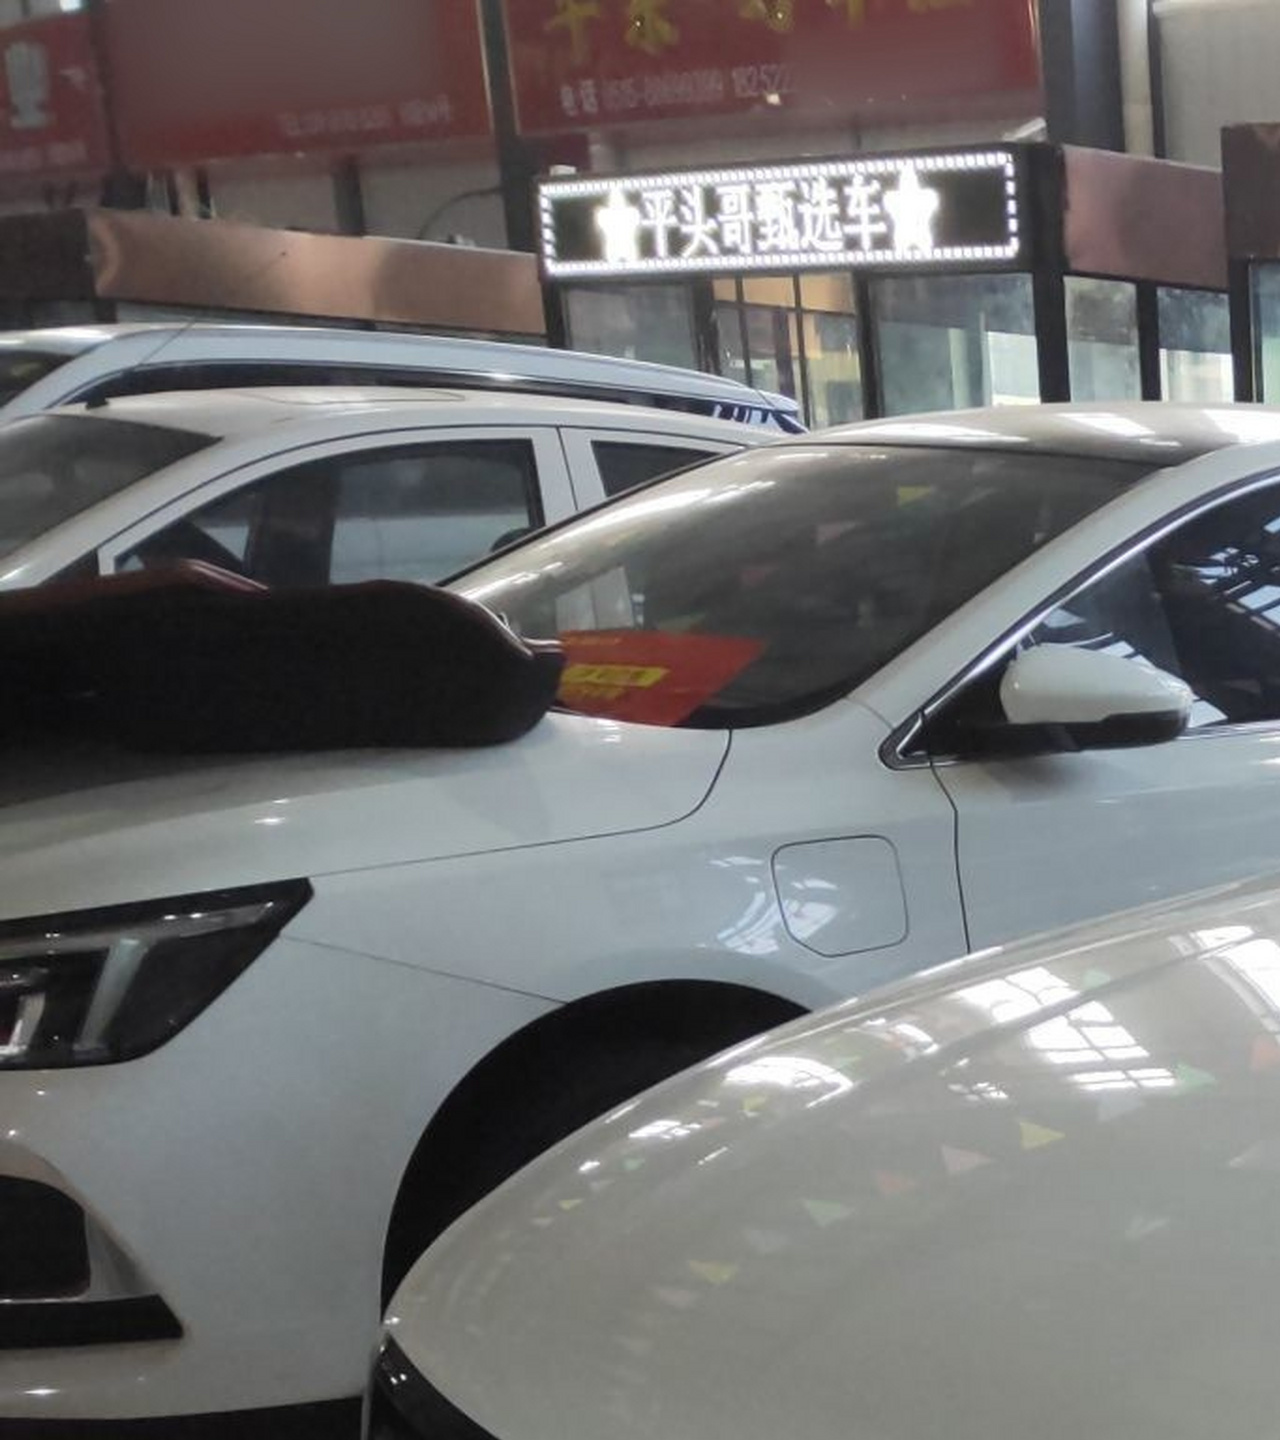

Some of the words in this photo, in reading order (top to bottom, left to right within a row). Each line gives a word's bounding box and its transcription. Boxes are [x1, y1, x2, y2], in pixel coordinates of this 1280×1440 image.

[639, 175, 886, 259] 平头哥甄选车
